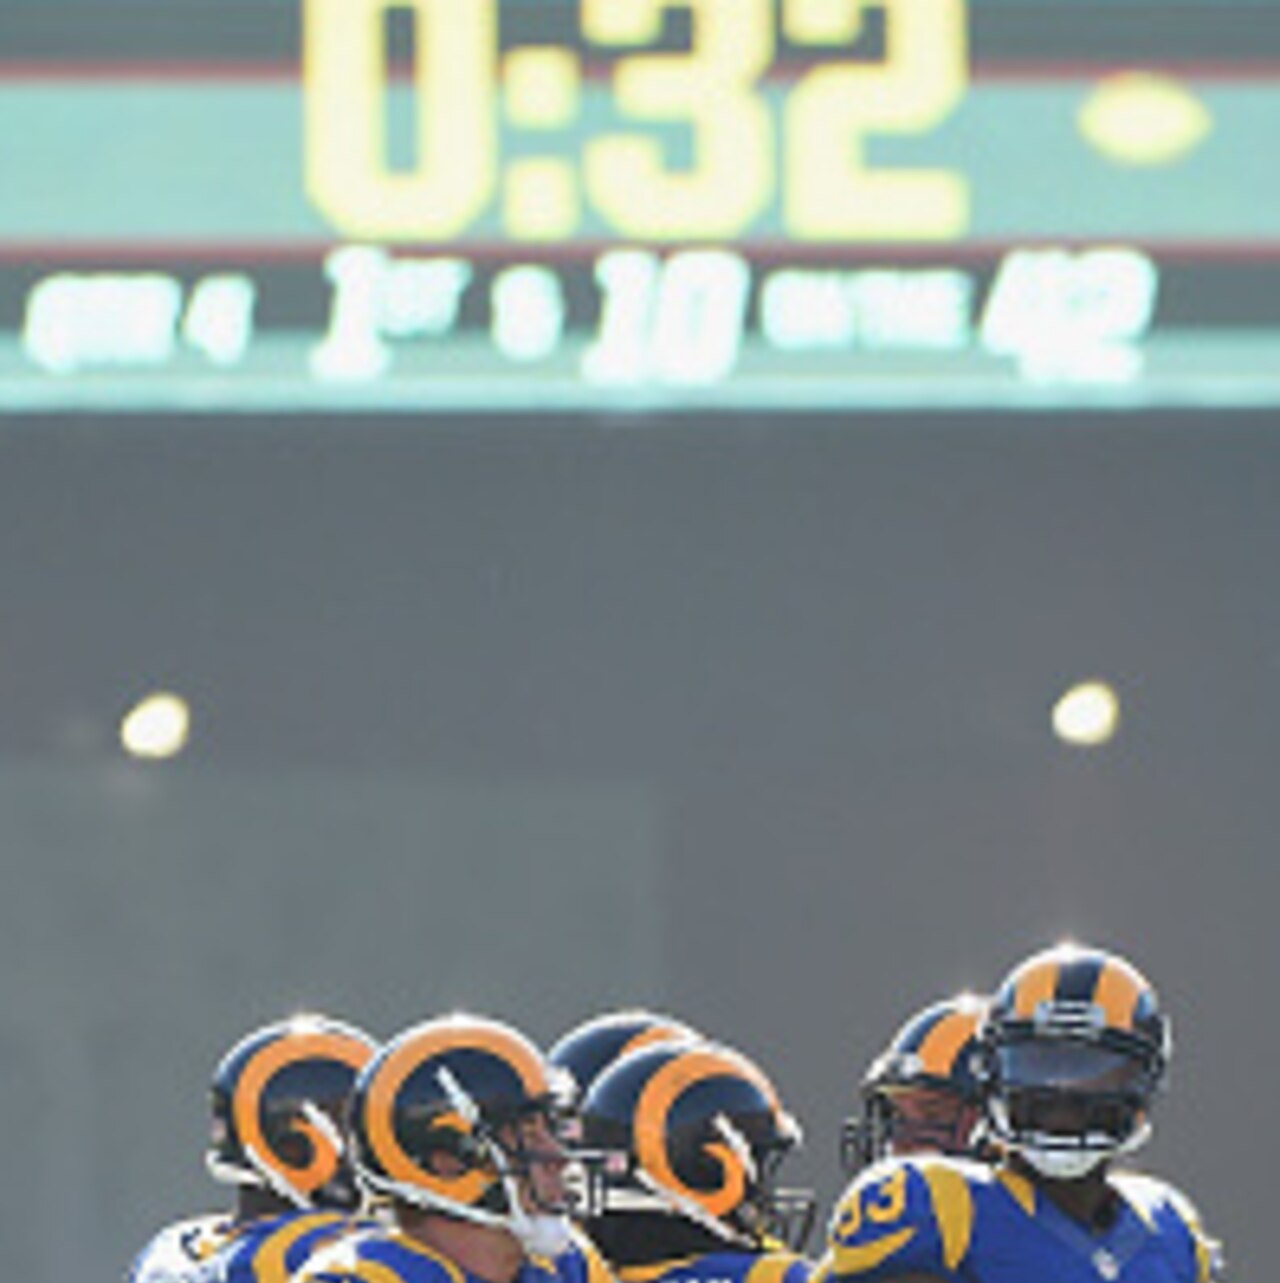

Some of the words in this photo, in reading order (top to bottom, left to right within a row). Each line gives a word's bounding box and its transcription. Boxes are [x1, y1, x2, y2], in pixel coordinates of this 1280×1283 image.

[305, 0, 970, 240] 0:32
[582, 248, 751, 385] 10
[982, 248, 1159, 385] 42
